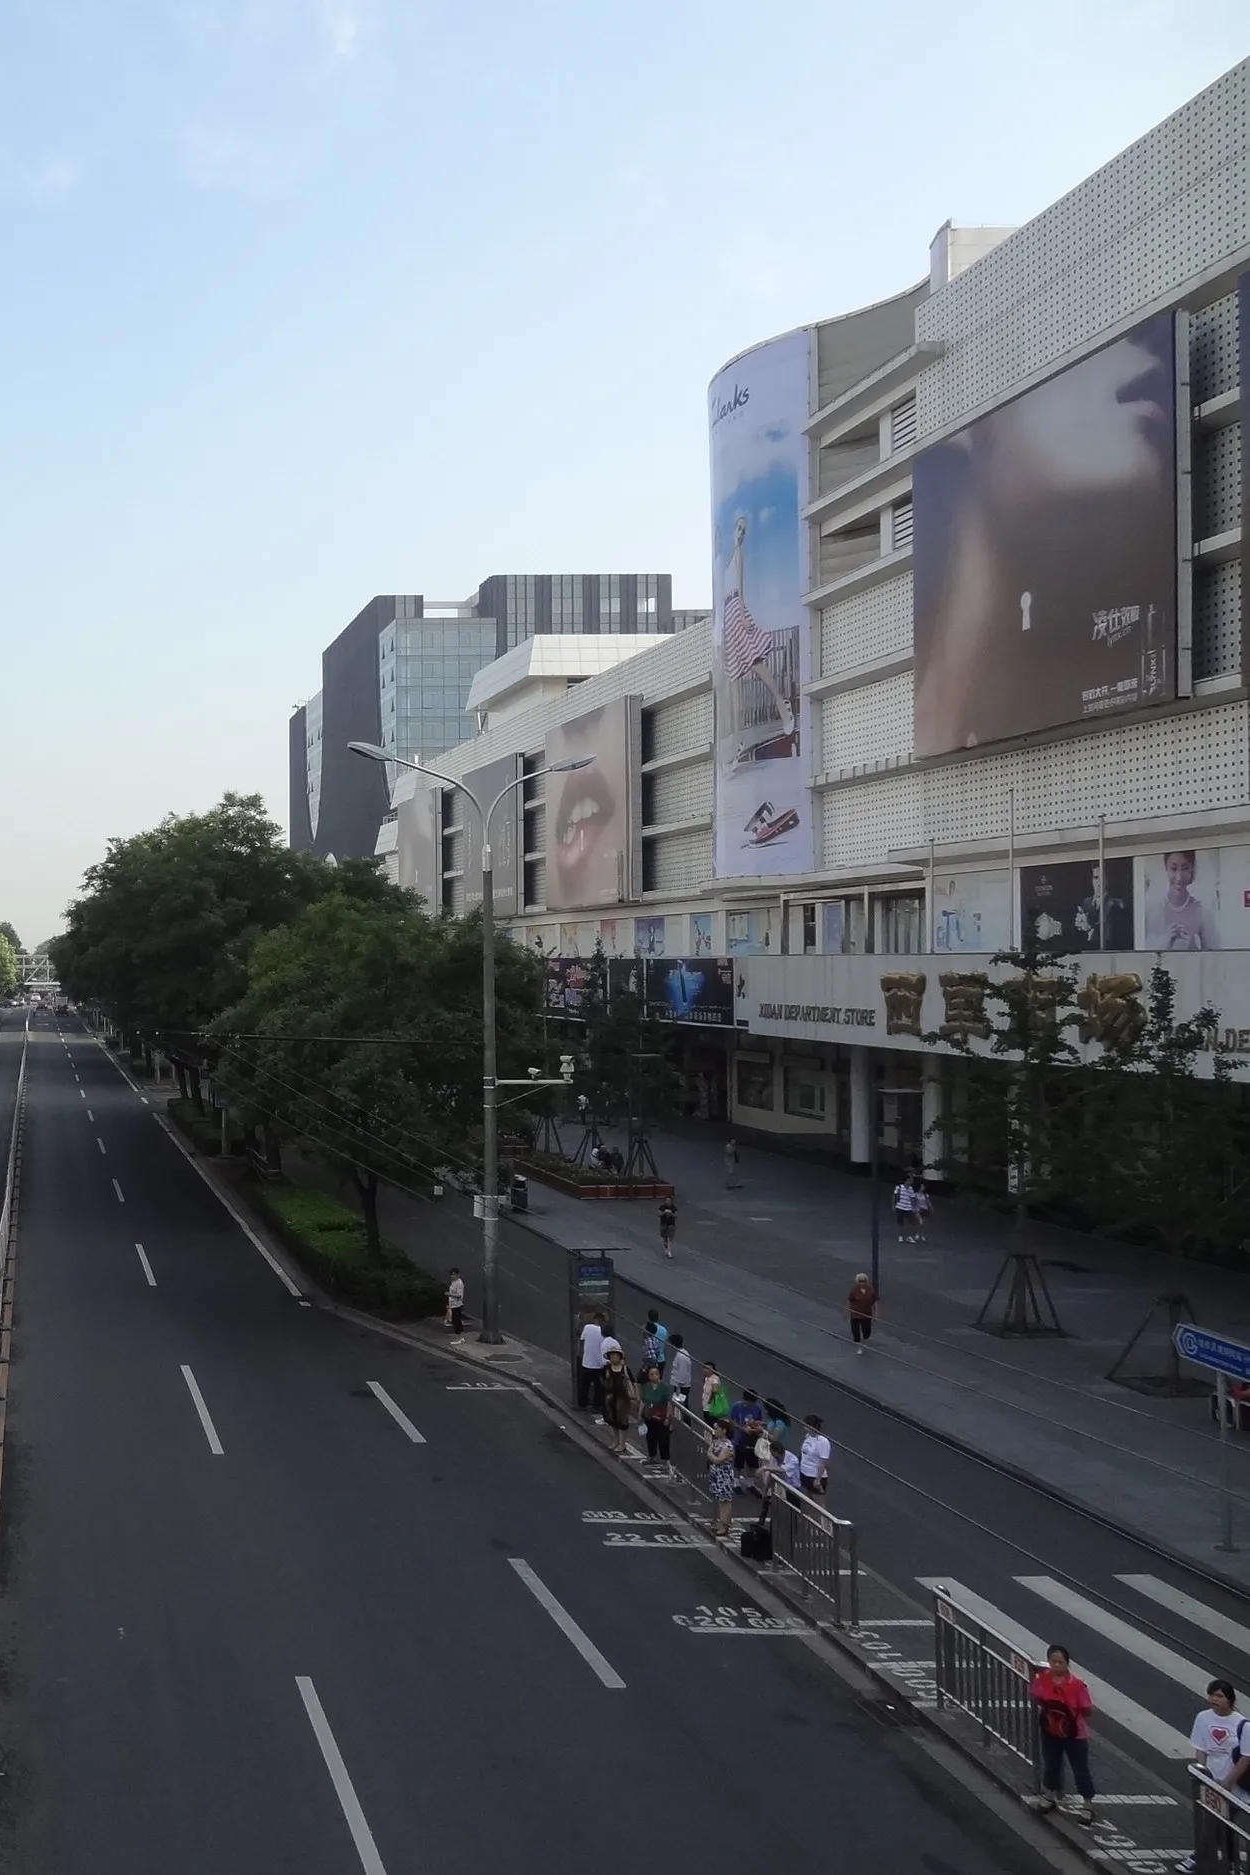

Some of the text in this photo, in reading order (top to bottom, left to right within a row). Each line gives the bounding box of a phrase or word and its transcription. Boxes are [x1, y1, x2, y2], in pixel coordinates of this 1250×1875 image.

[758, 1002, 876, 1027] XIDAN DEPARTMENT STORE
[606, 1532, 647, 1543] 22
[695, 1605, 762, 1618] 105
